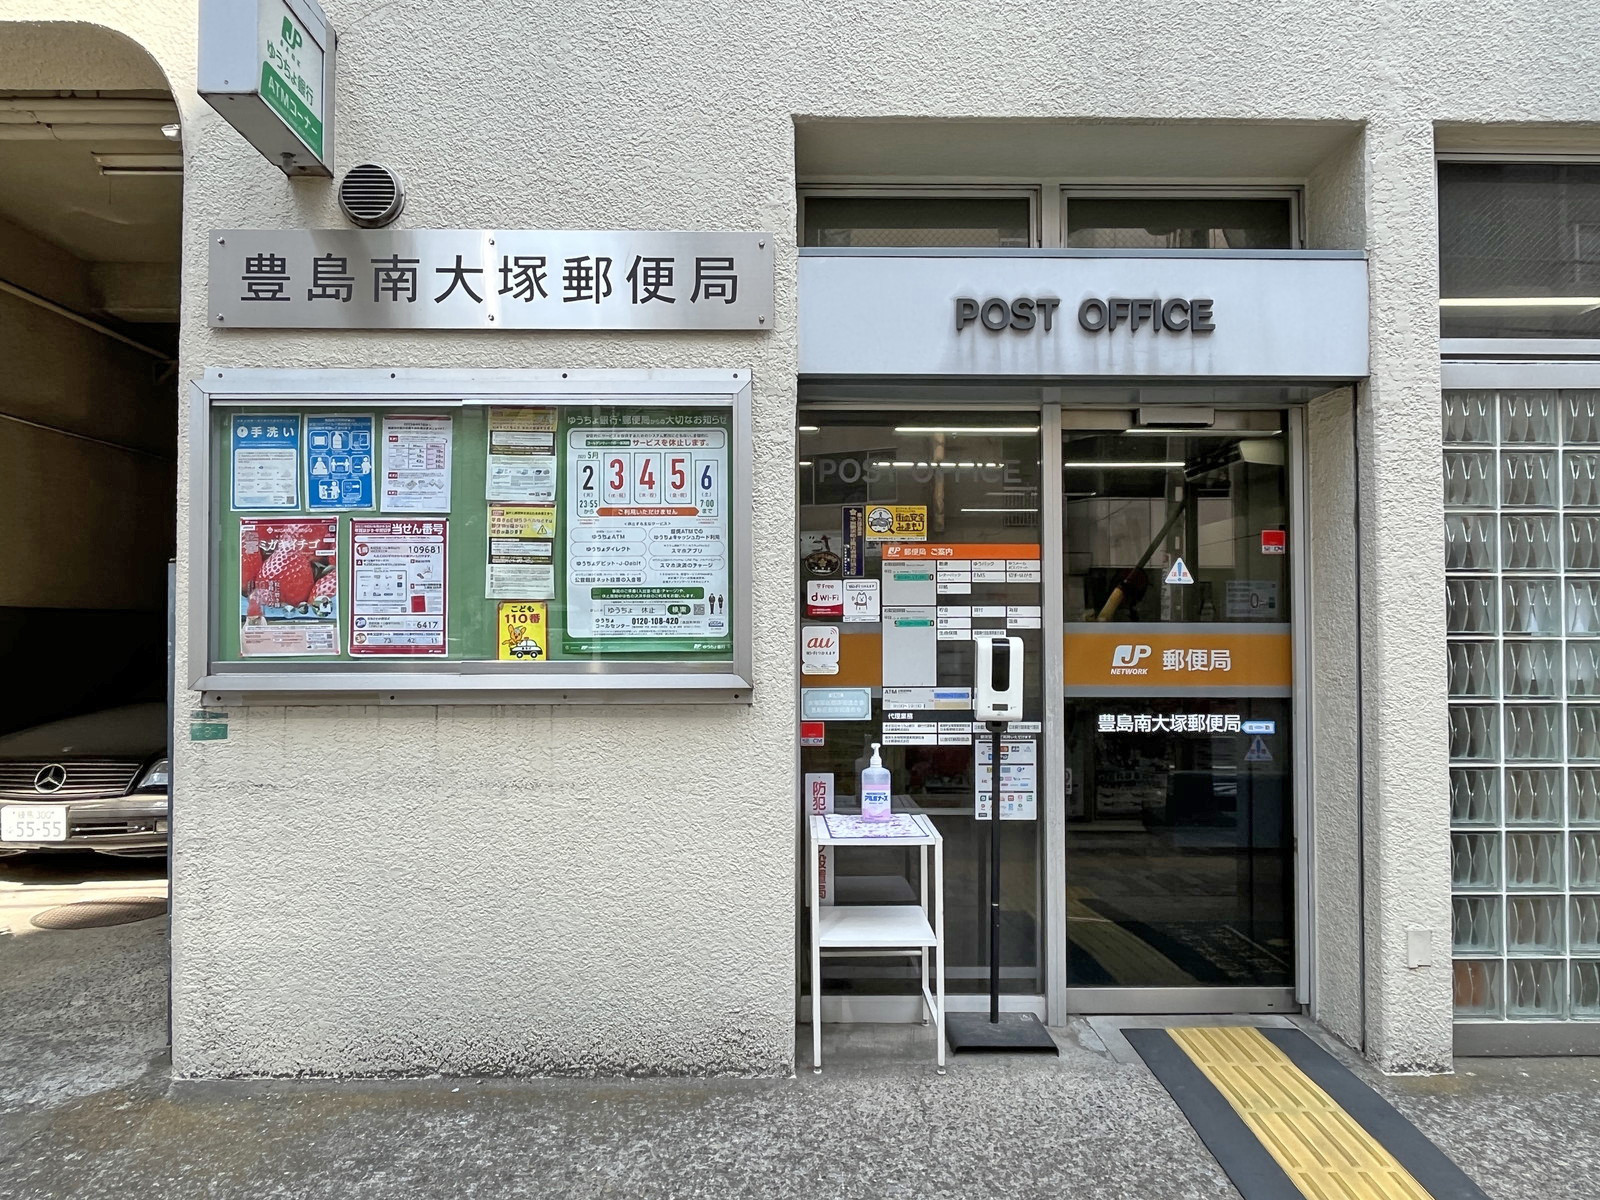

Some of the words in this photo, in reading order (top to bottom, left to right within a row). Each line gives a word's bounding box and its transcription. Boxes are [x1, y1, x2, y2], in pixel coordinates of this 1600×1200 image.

[266, 39, 314, 106] ゆうちょ銀行
[268, 76, 318, 135] ATMコーナー
[240, 253, 738, 305] 豊島南大塚郵便局
[955, 297, 1060, 333] POST
[1077, 297, 1216, 333] OFFICE
[251, 426, 294, 438] 手洗い
[632, 439, 709, 447] サービスを休止します。
[582, 465, 594, 490] 2
[610, 458, 624, 490] 3
[639, 458, 655, 489] 4
[671, 458, 685, 490] 5
[701, 465, 712, 490] 6
[579, 500, 598, 508] 23:55
[700, 499, 714, 508] 7:00
[392, 523, 444, 535] 当せん番号
[409, 545, 441, 554] 109681
[904, 548, 926, 556] 郵便局
[931, 548, 954, 556] ご案内
[511, 605, 535, 613] こども
[416, 620, 438, 629] 6417
[504, 613, 541, 624] 110番
[631, 617, 679, 625] 0120-108-420
[807, 636, 835, 649] au
[1112, 644, 1152, 667] JP
[1163, 649, 1231, 672] 郵便局
[1098, 714, 1241, 733] 豊島南大塚郵便局
[16, 821, 61, 838] 55-55
